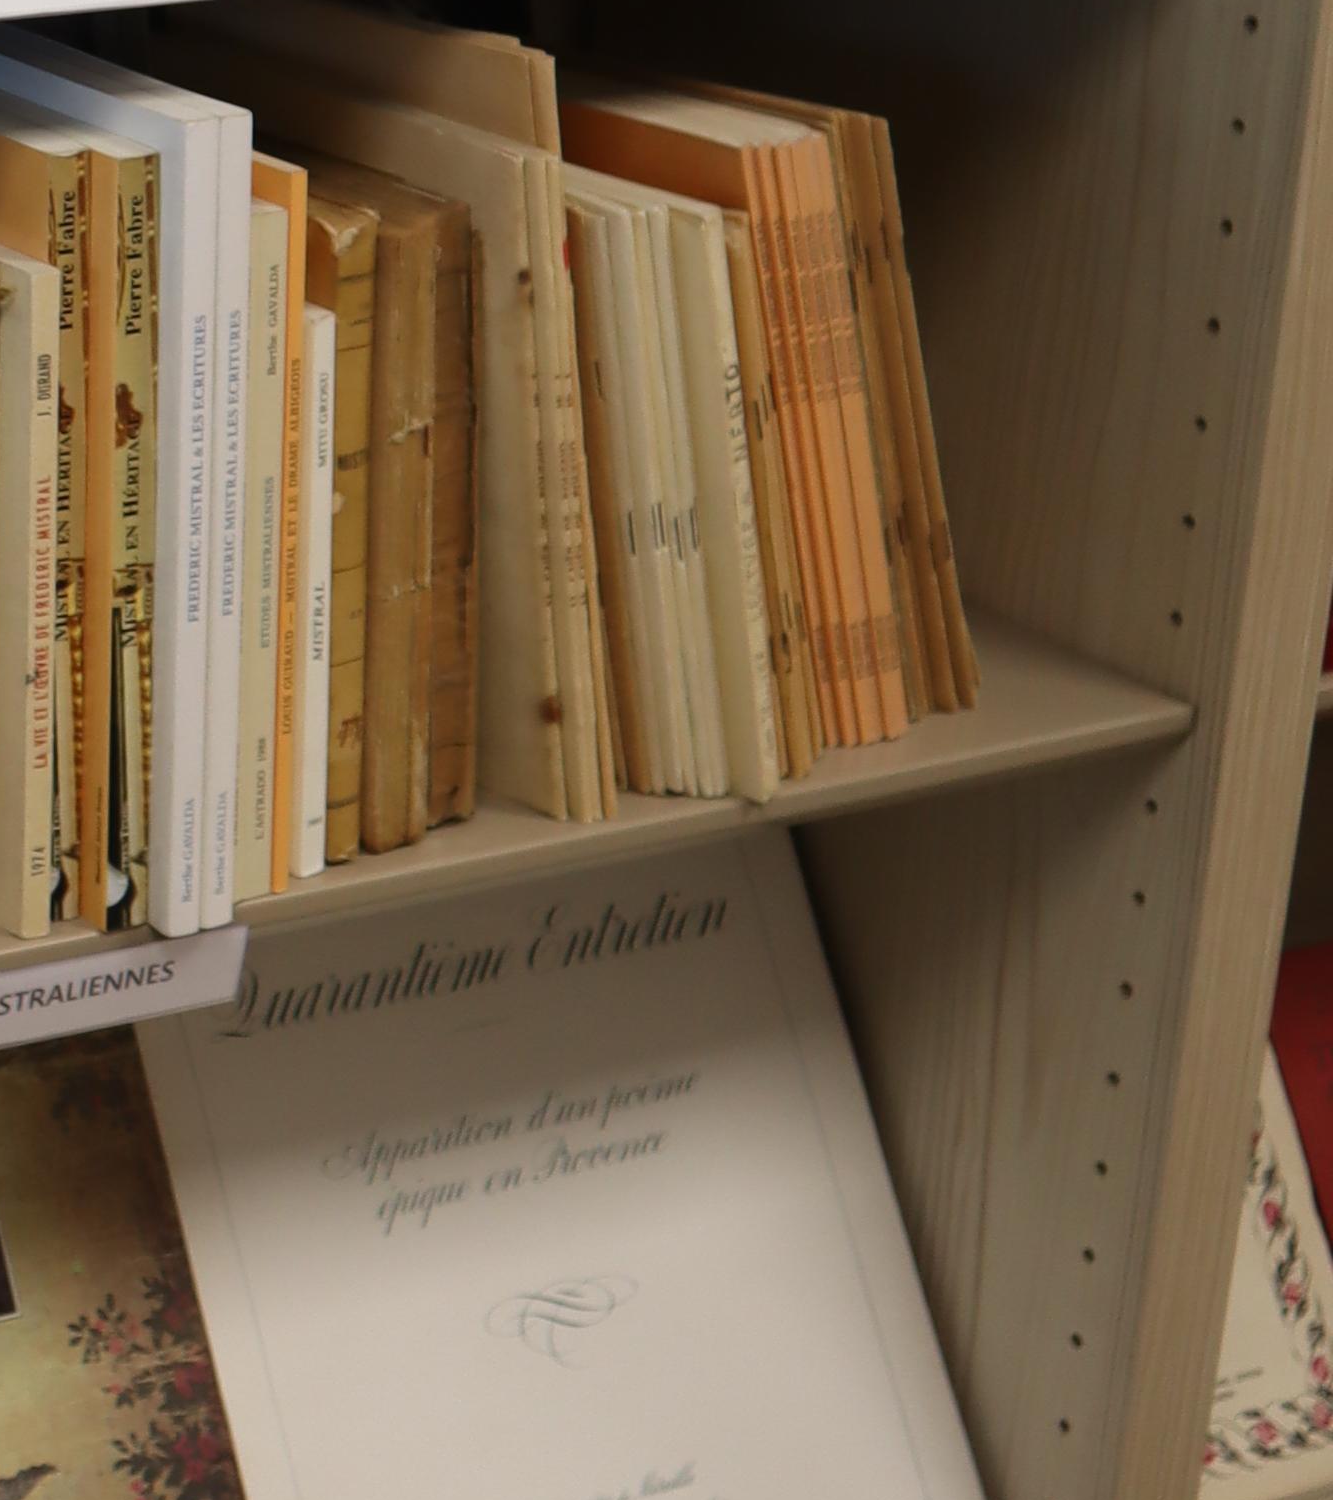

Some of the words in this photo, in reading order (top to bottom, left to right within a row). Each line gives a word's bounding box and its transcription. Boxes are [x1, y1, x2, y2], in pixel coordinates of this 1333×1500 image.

[127, 194, 144, 259] Fabre
[125, 265, 143, 336] Pierre
[312, 582, 326, 661] MISTRAL
